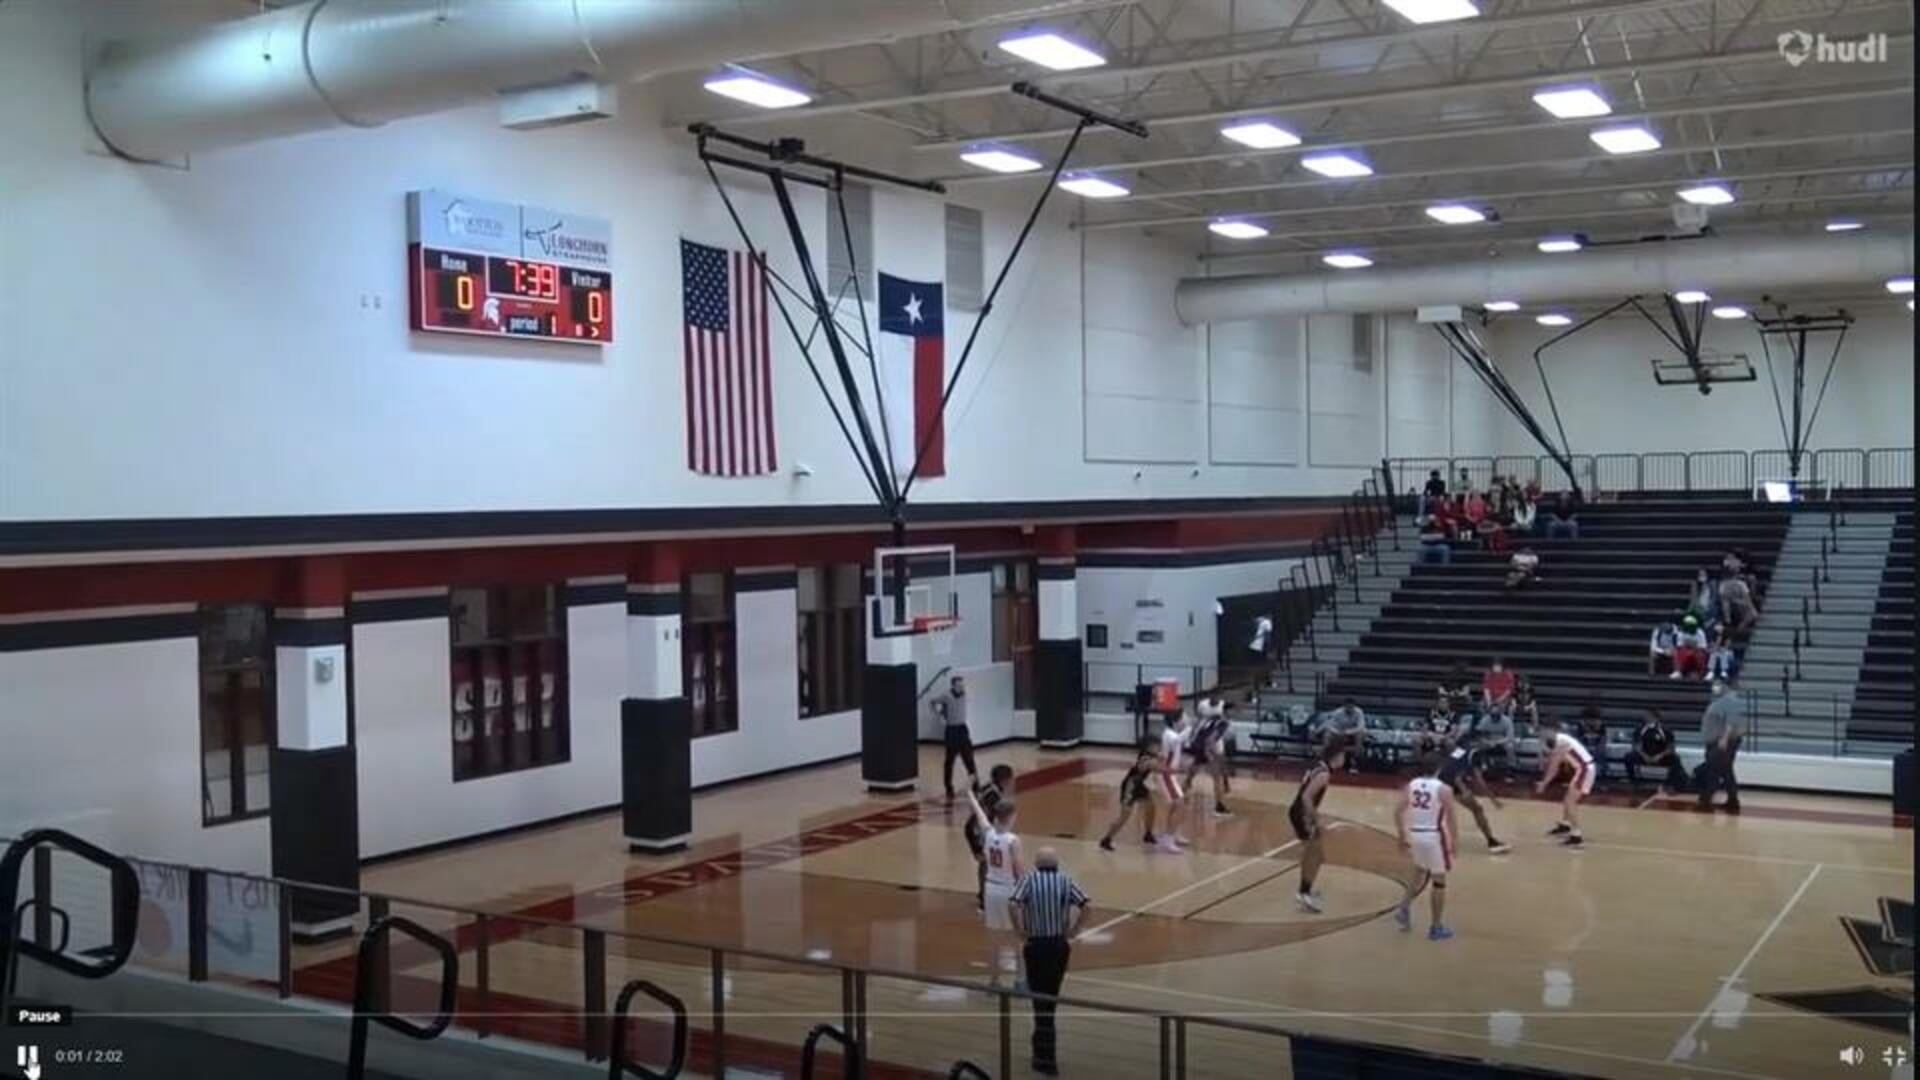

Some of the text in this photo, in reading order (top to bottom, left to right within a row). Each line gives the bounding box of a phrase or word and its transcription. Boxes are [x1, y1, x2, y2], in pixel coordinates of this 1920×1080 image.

[505, 260, 556, 297] 7:39
[571, 270, 602, 288] Visitor
[458, 276, 474, 310] 0
[588, 291, 603, 323] 0
[510, 316, 539, 333] period
[550, 315, 557, 335] 1
[1412, 789, 1431, 809] 32
